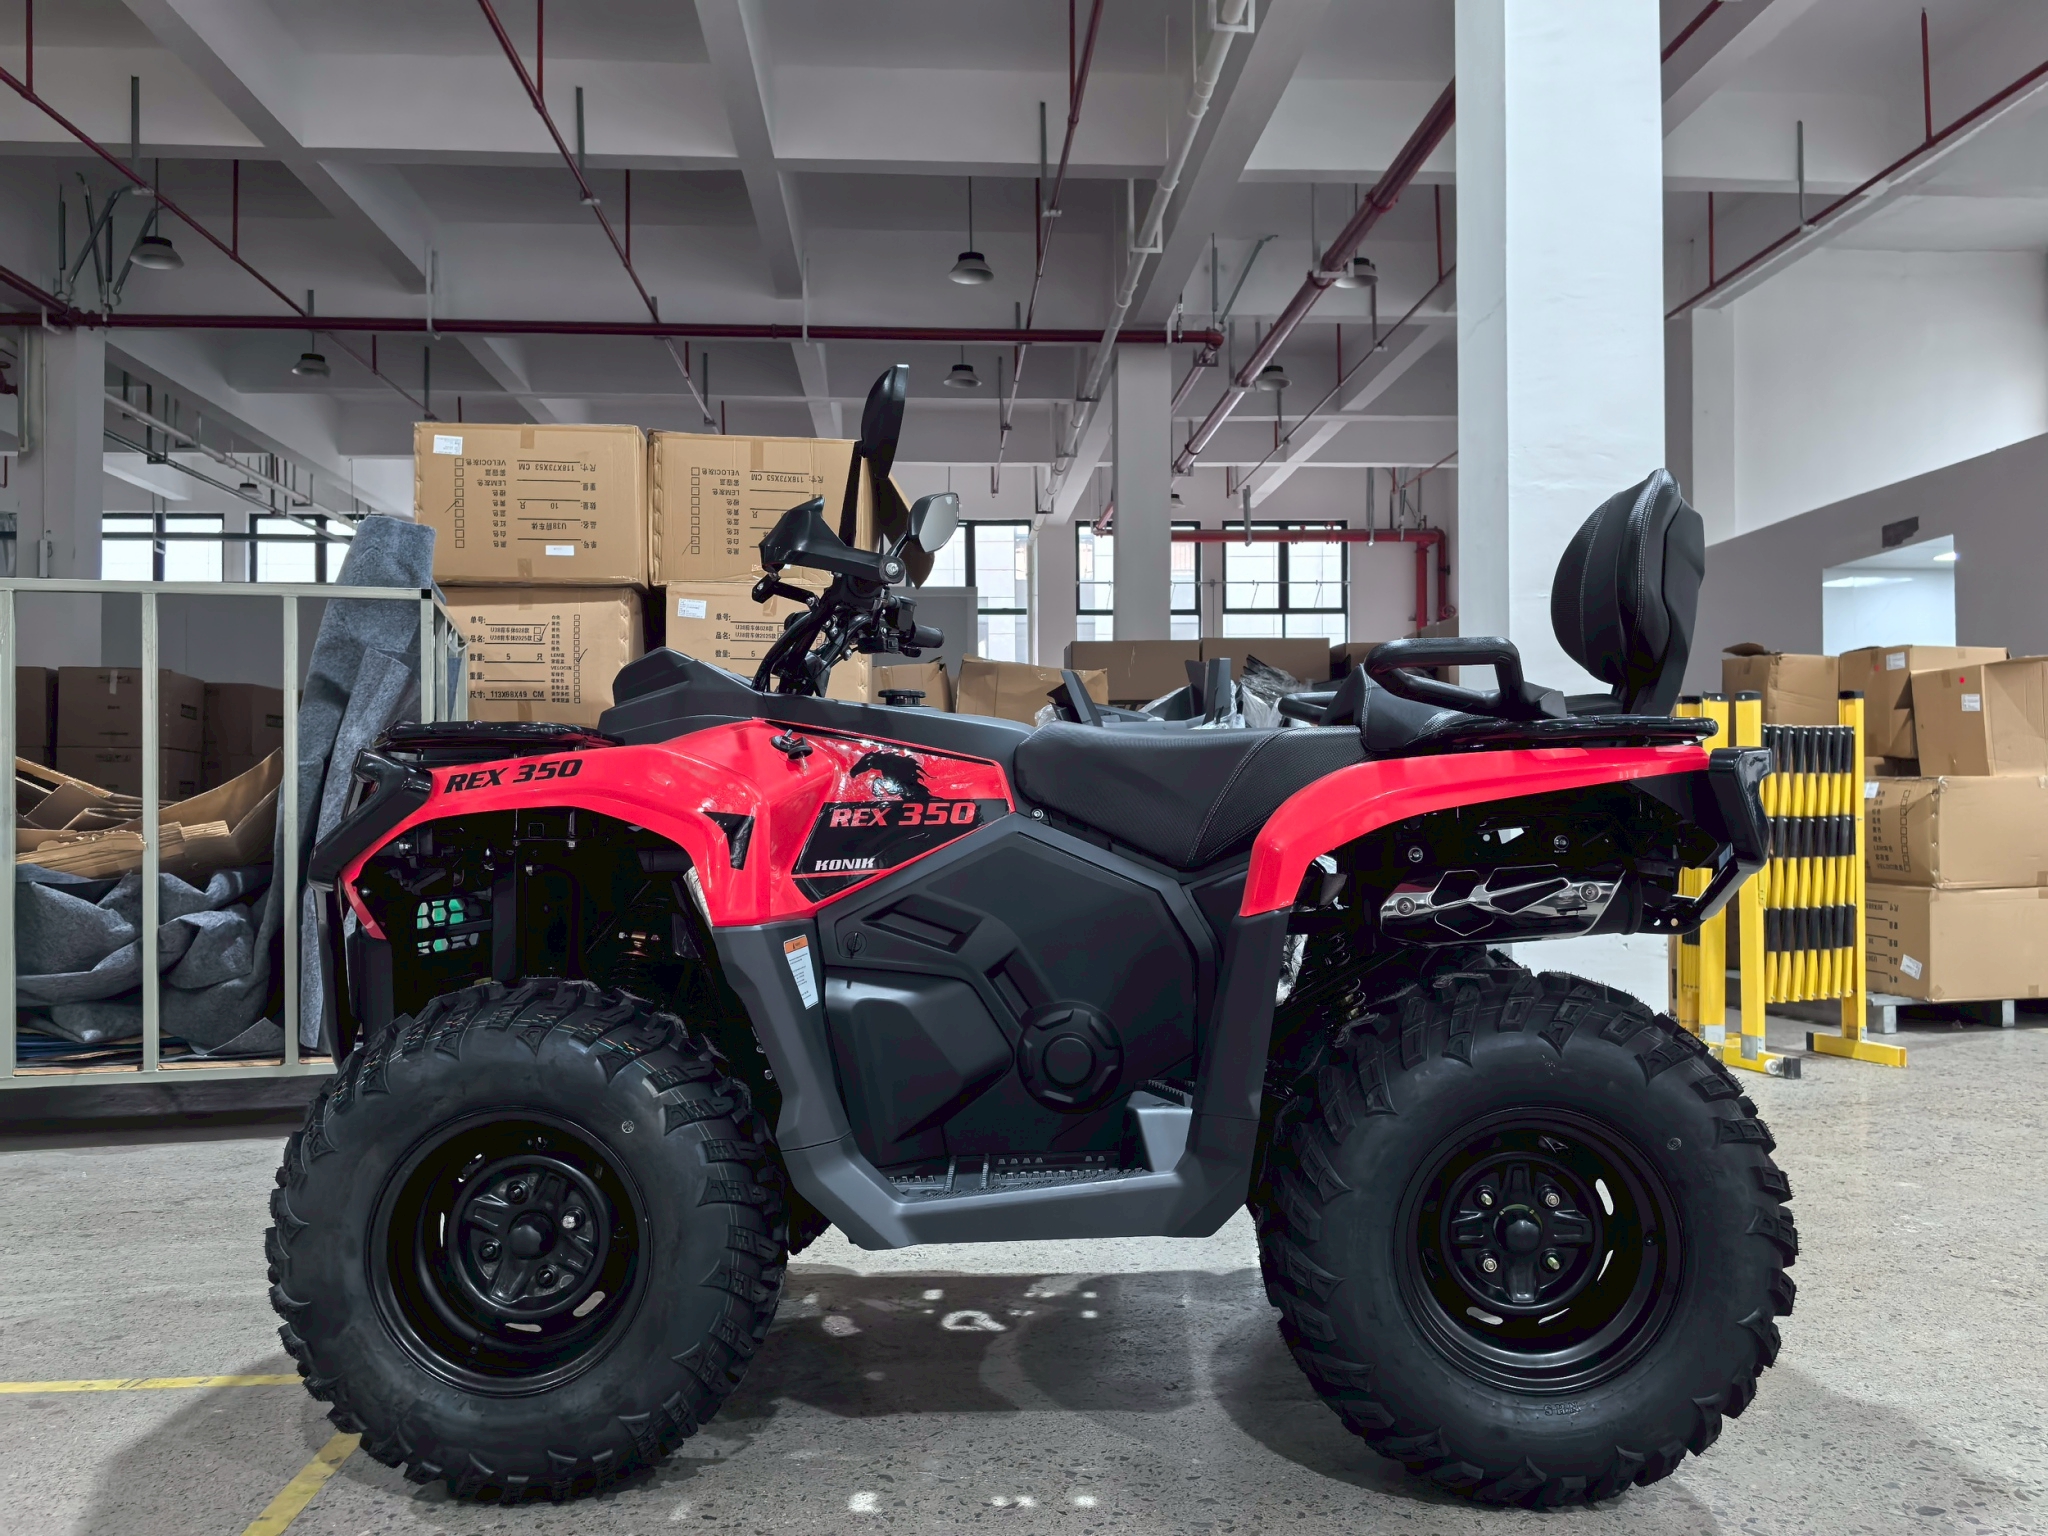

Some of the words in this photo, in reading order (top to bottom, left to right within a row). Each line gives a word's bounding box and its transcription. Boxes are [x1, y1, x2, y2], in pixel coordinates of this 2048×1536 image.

[535, 463, 575, 471] 118X73X53
[766, 474, 804, 483] 118X73X53
[444, 767, 508, 794] REX
[512, 759, 583, 784] 350
[830, 807, 891, 828] REX
[898, 802, 976, 825] 350
[815, 857, 876, 871] KONIK
